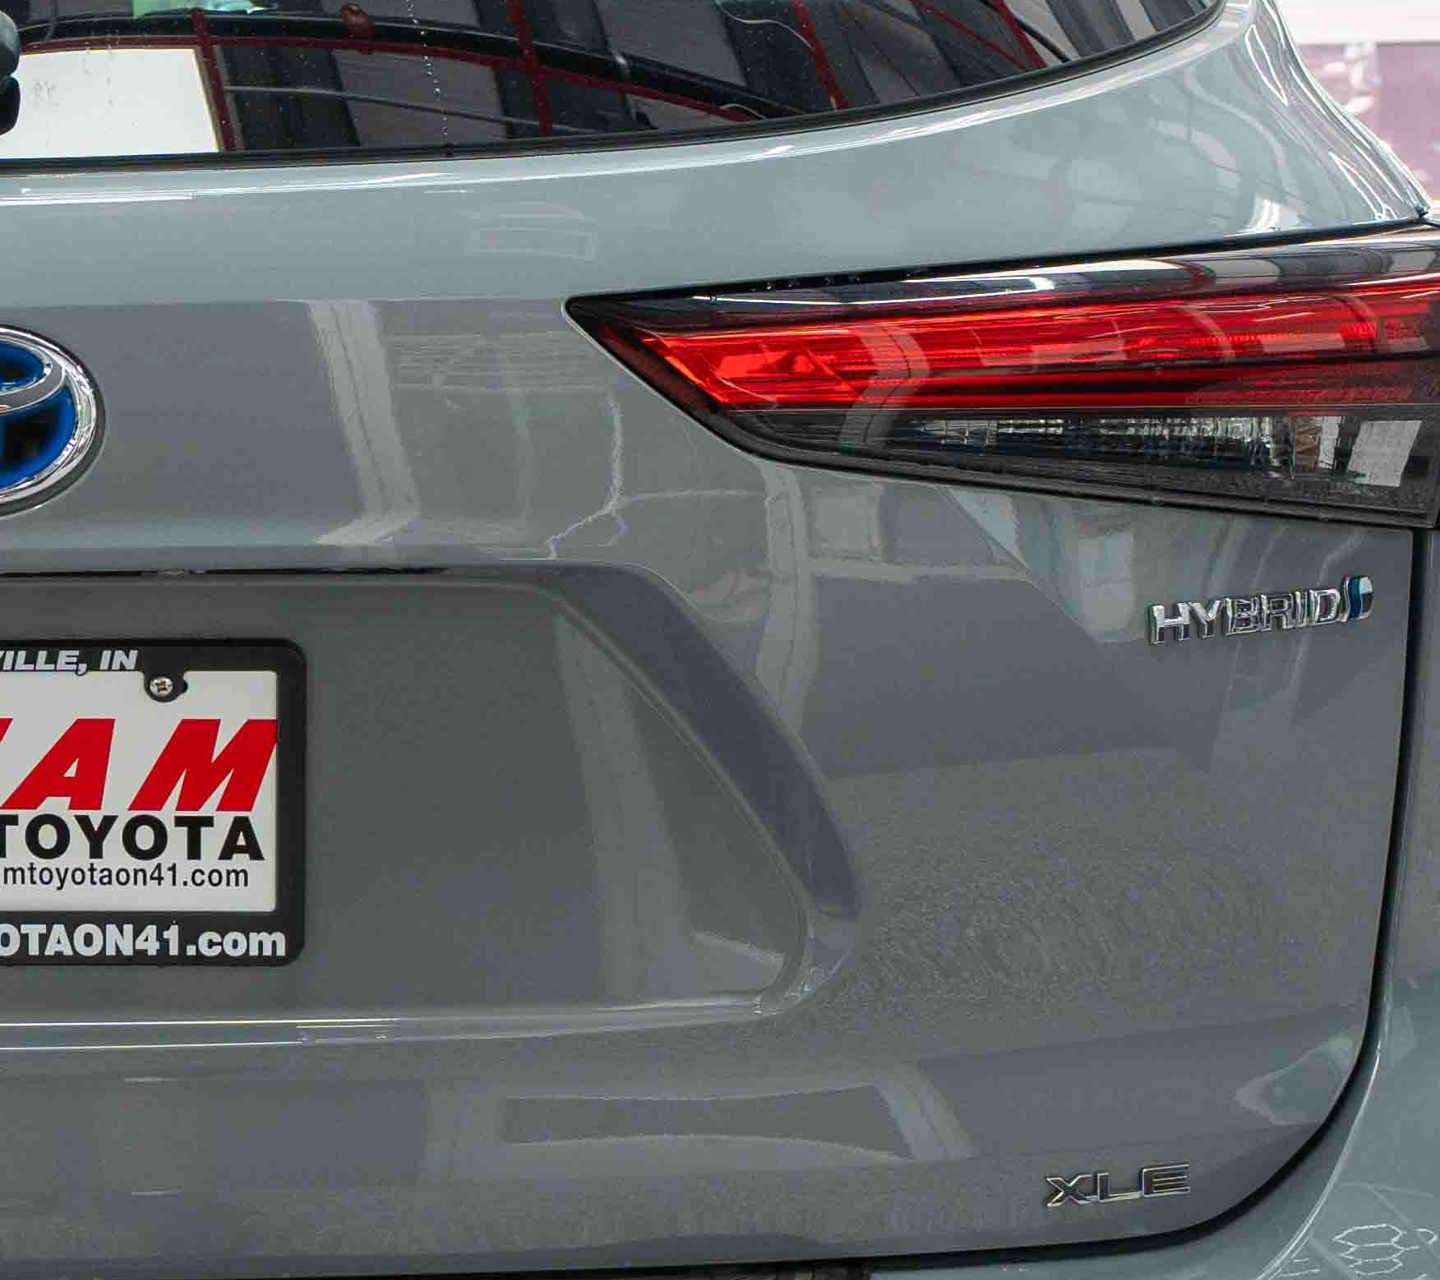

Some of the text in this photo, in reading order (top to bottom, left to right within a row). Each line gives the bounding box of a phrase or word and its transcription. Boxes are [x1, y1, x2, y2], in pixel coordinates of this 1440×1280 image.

[1148, 587, 1341, 645] HYBRID
[99, 650, 138, 670] IN
[1046, 1160, 1191, 1208] XLE
